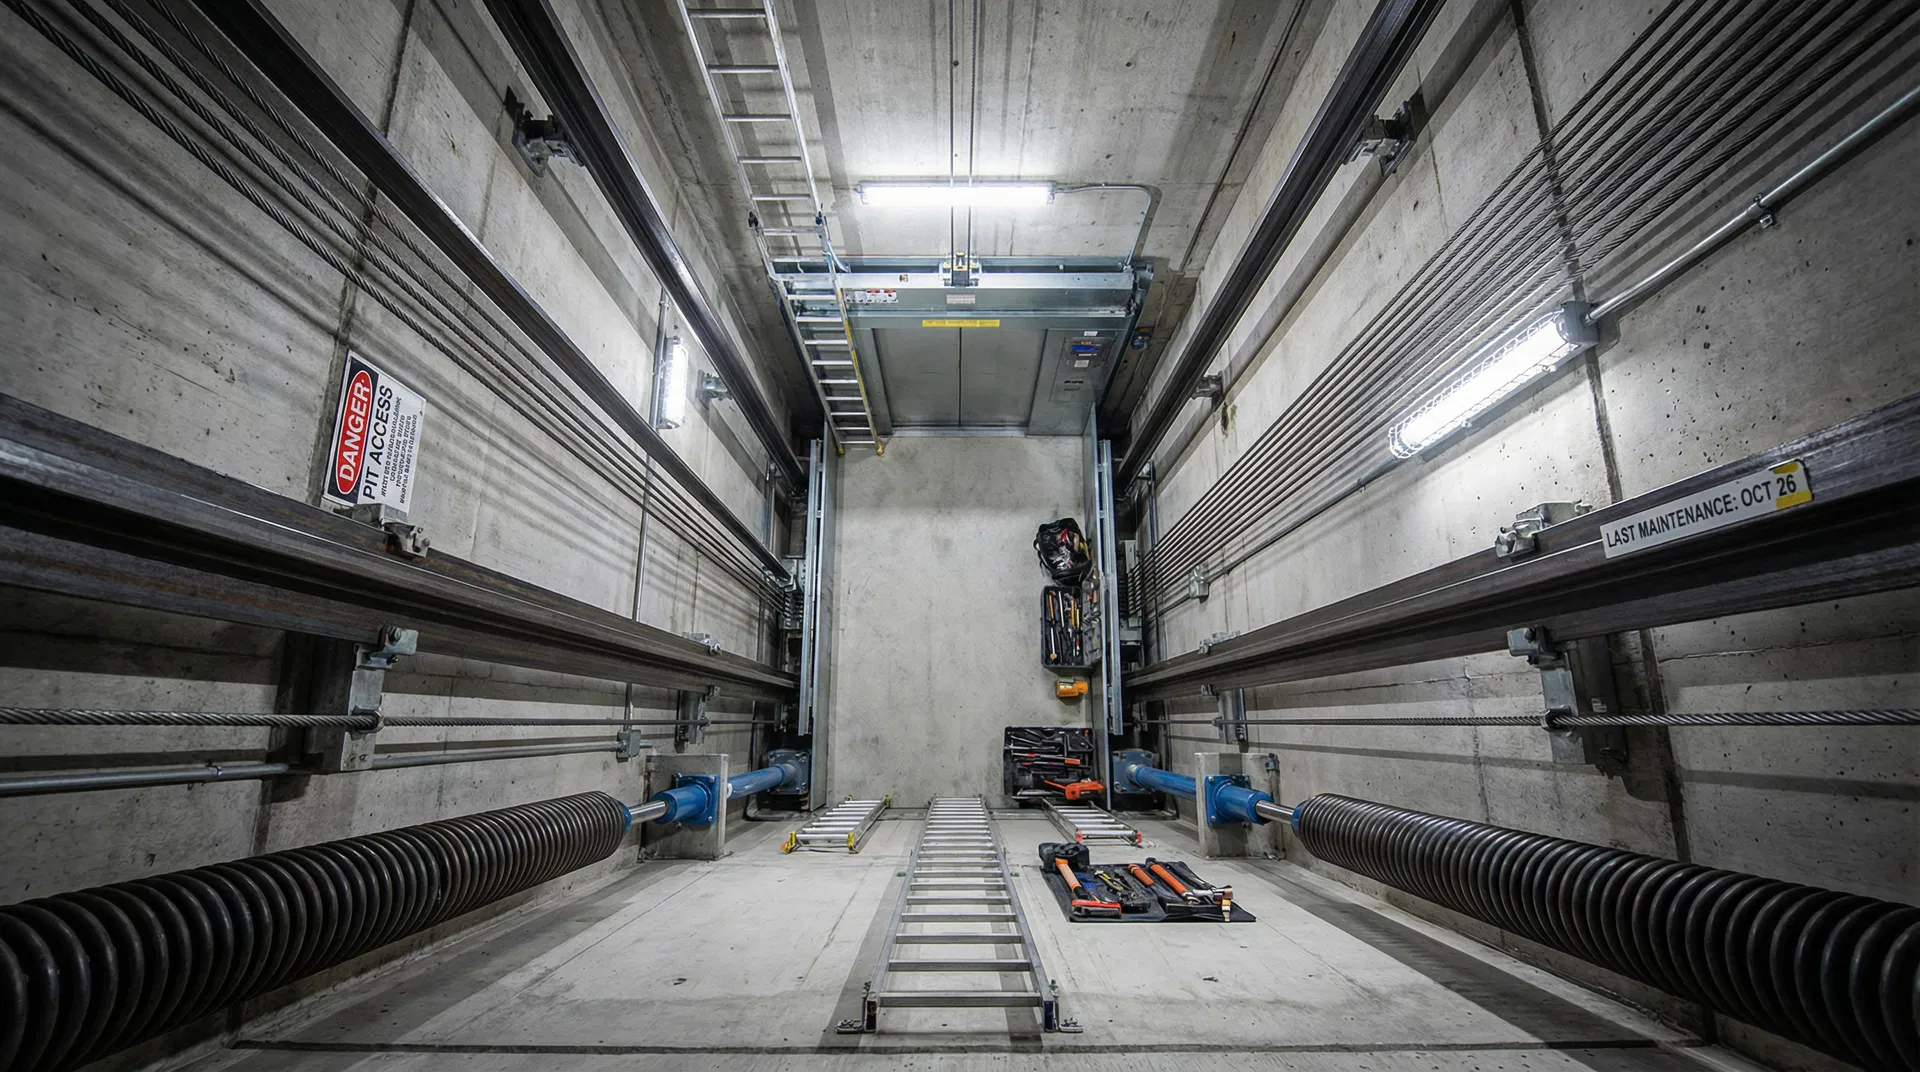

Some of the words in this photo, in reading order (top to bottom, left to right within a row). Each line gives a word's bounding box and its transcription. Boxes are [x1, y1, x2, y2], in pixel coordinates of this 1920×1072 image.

[339, 381, 371, 482] DANGER
[369, 385, 393, 466] ACCESS
[362, 466, 380, 500] PIT
[1606, 524, 1636, 548] LAST
[1638, 493, 1739, 539] MAINTENANCE:
[1740, 480, 1772, 507] OCT
[1776, 474, 1797, 497] 26
